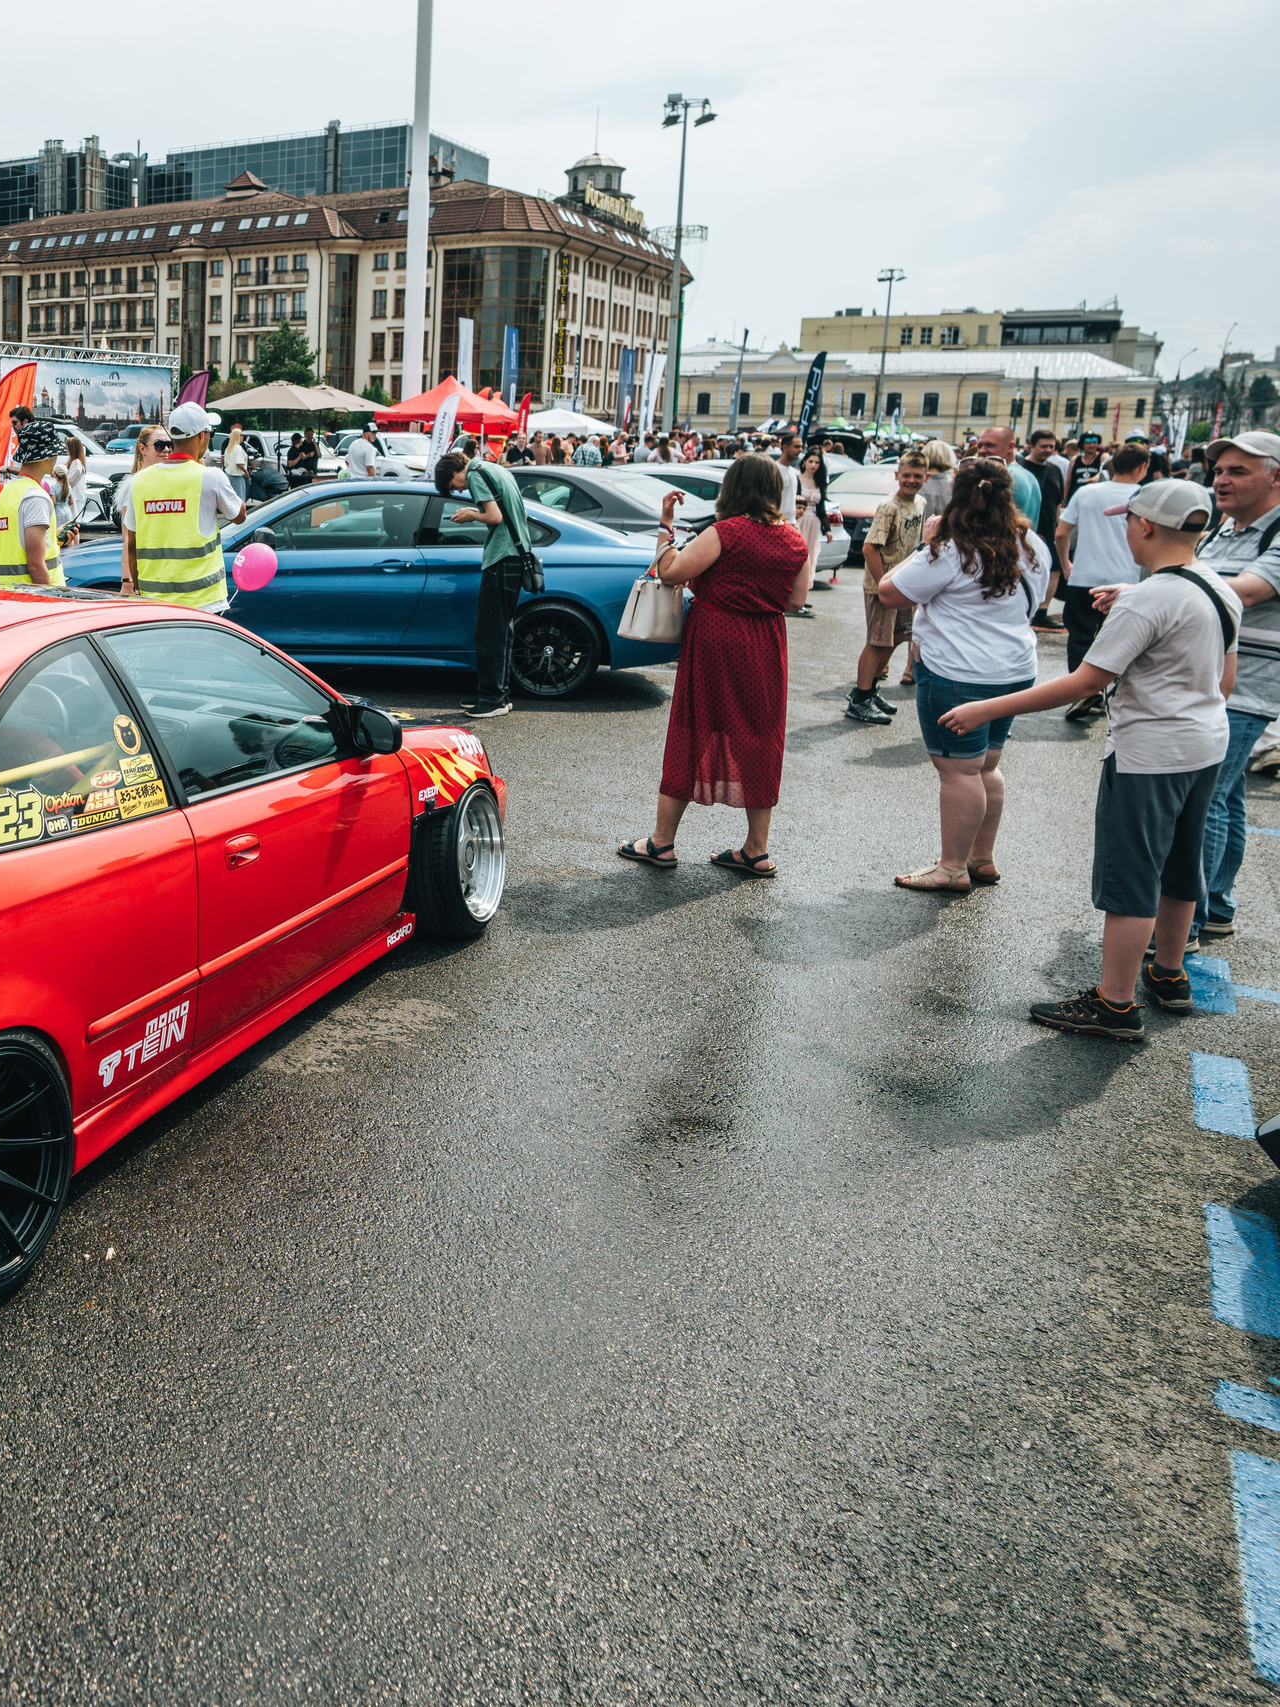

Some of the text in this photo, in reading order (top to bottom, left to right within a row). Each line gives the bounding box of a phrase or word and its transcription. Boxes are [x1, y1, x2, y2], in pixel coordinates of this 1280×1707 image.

[55, 377, 91, 386] CHANGAN
[146, 501, 184, 512] MOTUL
[91, 770, 120, 787] FMF
[419, 784, 439, 802] EXEDY
[45, 791, 86, 815] Option
[78, 809, 119, 827] DUNLOP
[387, 922, 413, 948] RECARO
[123, 1014, 188, 1072] TEIN
